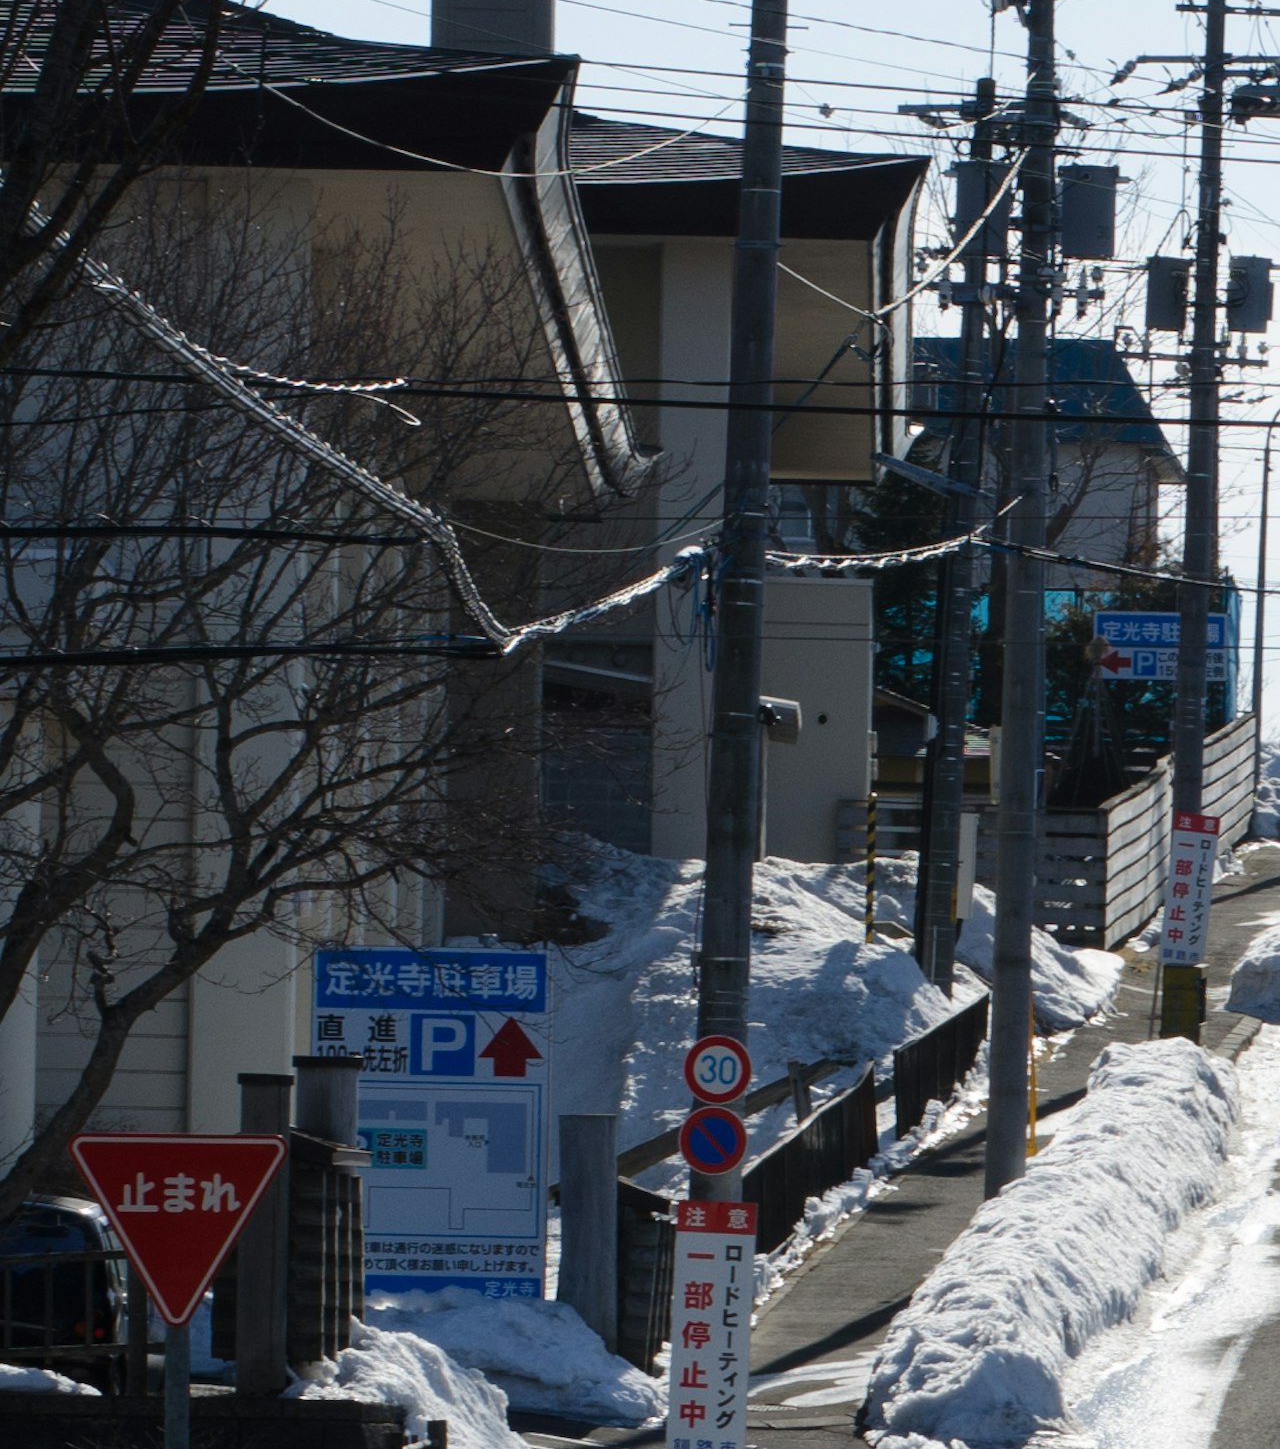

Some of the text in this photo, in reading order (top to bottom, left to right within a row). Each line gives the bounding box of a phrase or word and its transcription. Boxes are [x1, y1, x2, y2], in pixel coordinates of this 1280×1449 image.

[1102, 621, 1220, 643] 定光寺駐場
[1138, 652, 1155, 674] P
[1167, 841, 1195, 944] 一部停止中
[1188, 839, 1211, 946] ロードヒーティング
[325, 961, 539, 1000] 定光寺駐車場
[317, 1014, 397, 1043] 直進
[421, 1018, 467, 1071] P
[701, 1055, 737, 1085] 30
[376, 1133, 424, 1149] 定光寺
[376, 1150, 424, 1165] 駐車場
[117, 1171, 242, 1214] 止まれ
[685, 1206, 749, 1229] 注意
[365, 1241, 539, 1257] 車は通行の迷惑になりますので
[484, 1281, 535, 1298] 定光寺
[679, 1252, 715, 1429] 一部停止中
[715, 1245, 743, 1430] ロードヒーティング
